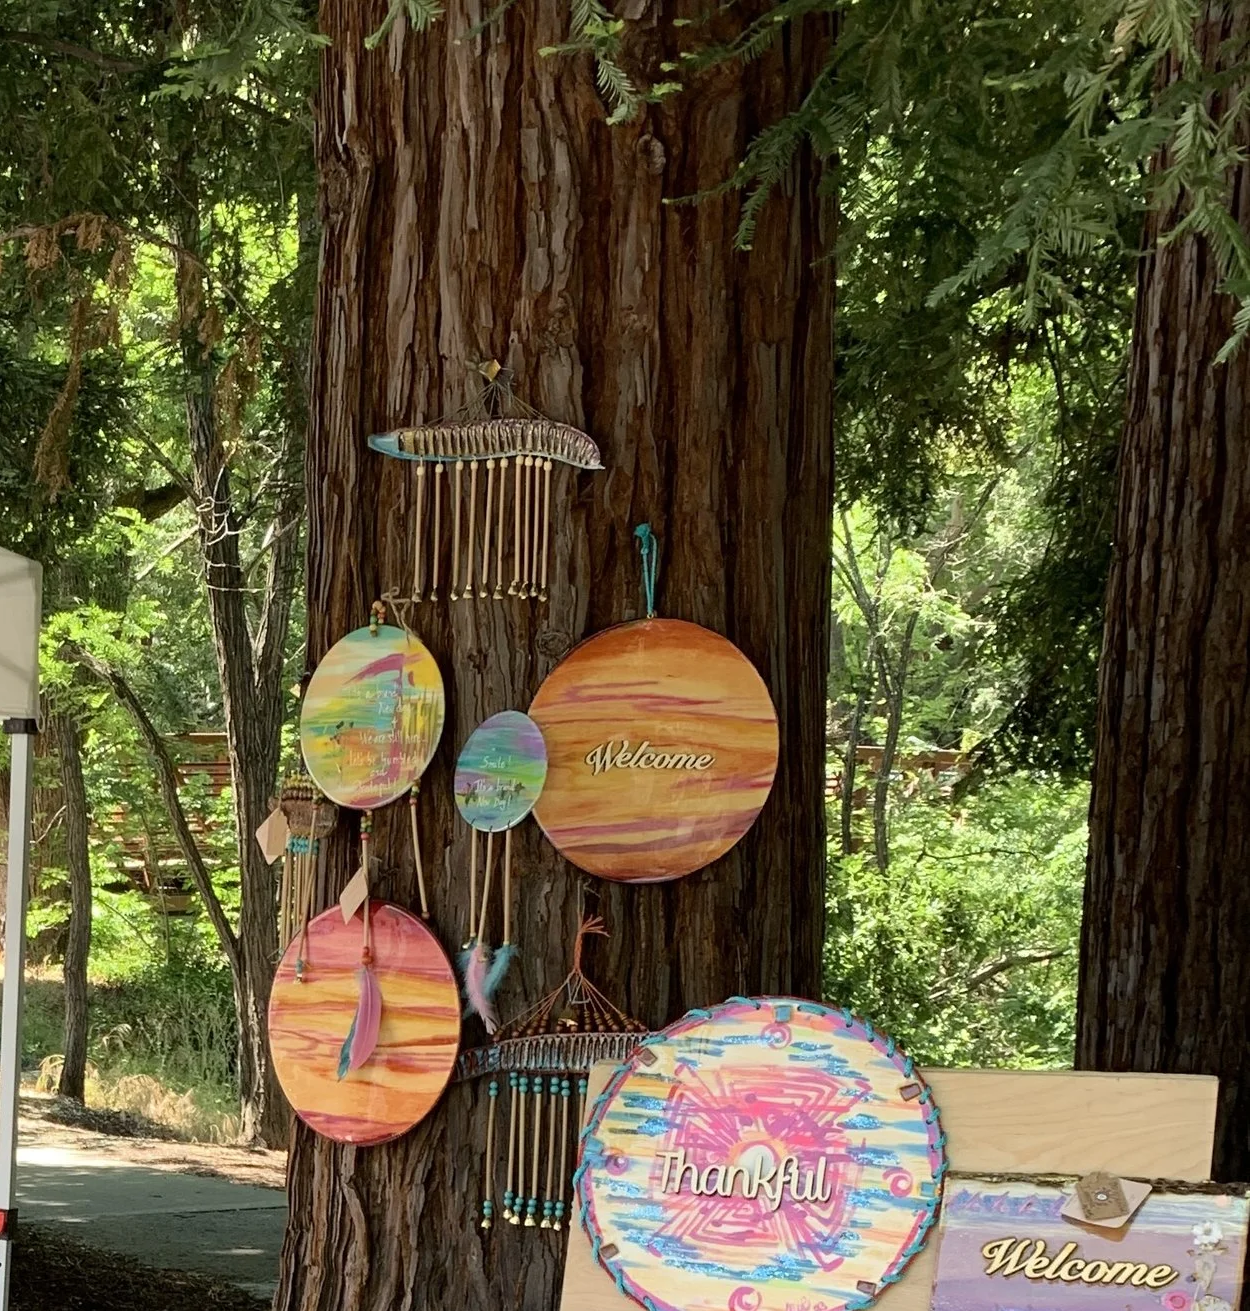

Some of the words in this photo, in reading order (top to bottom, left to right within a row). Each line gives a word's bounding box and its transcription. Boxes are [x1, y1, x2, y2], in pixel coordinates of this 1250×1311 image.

[584, 740, 715, 776] Welcome
[656, 1150, 831, 1212] Thankful
[981, 1237, 1179, 1288] Welcome
